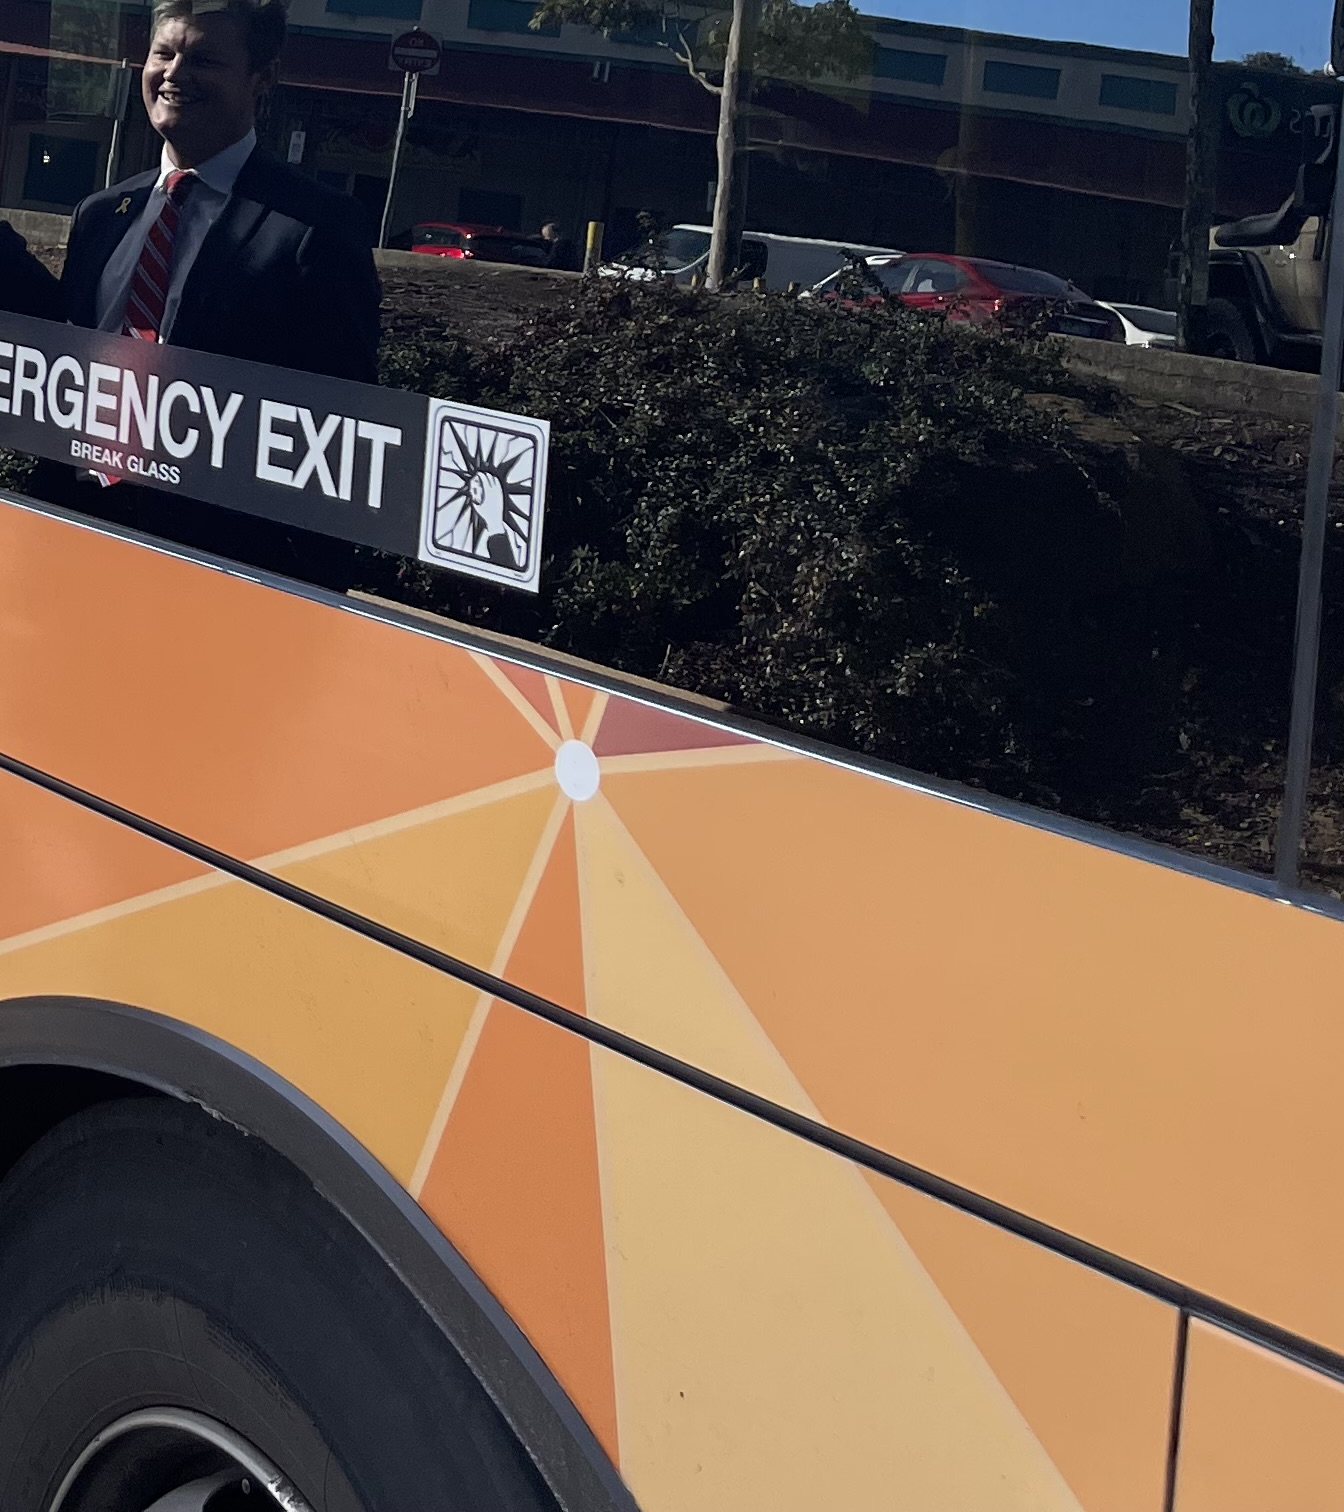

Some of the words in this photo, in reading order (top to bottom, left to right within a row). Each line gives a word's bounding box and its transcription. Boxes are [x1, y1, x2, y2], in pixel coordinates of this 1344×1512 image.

[71, 439, 124, 469] BREAK
[126, 453, 181, 485] GLASS
[256, 398, 402, 510] EXIT
